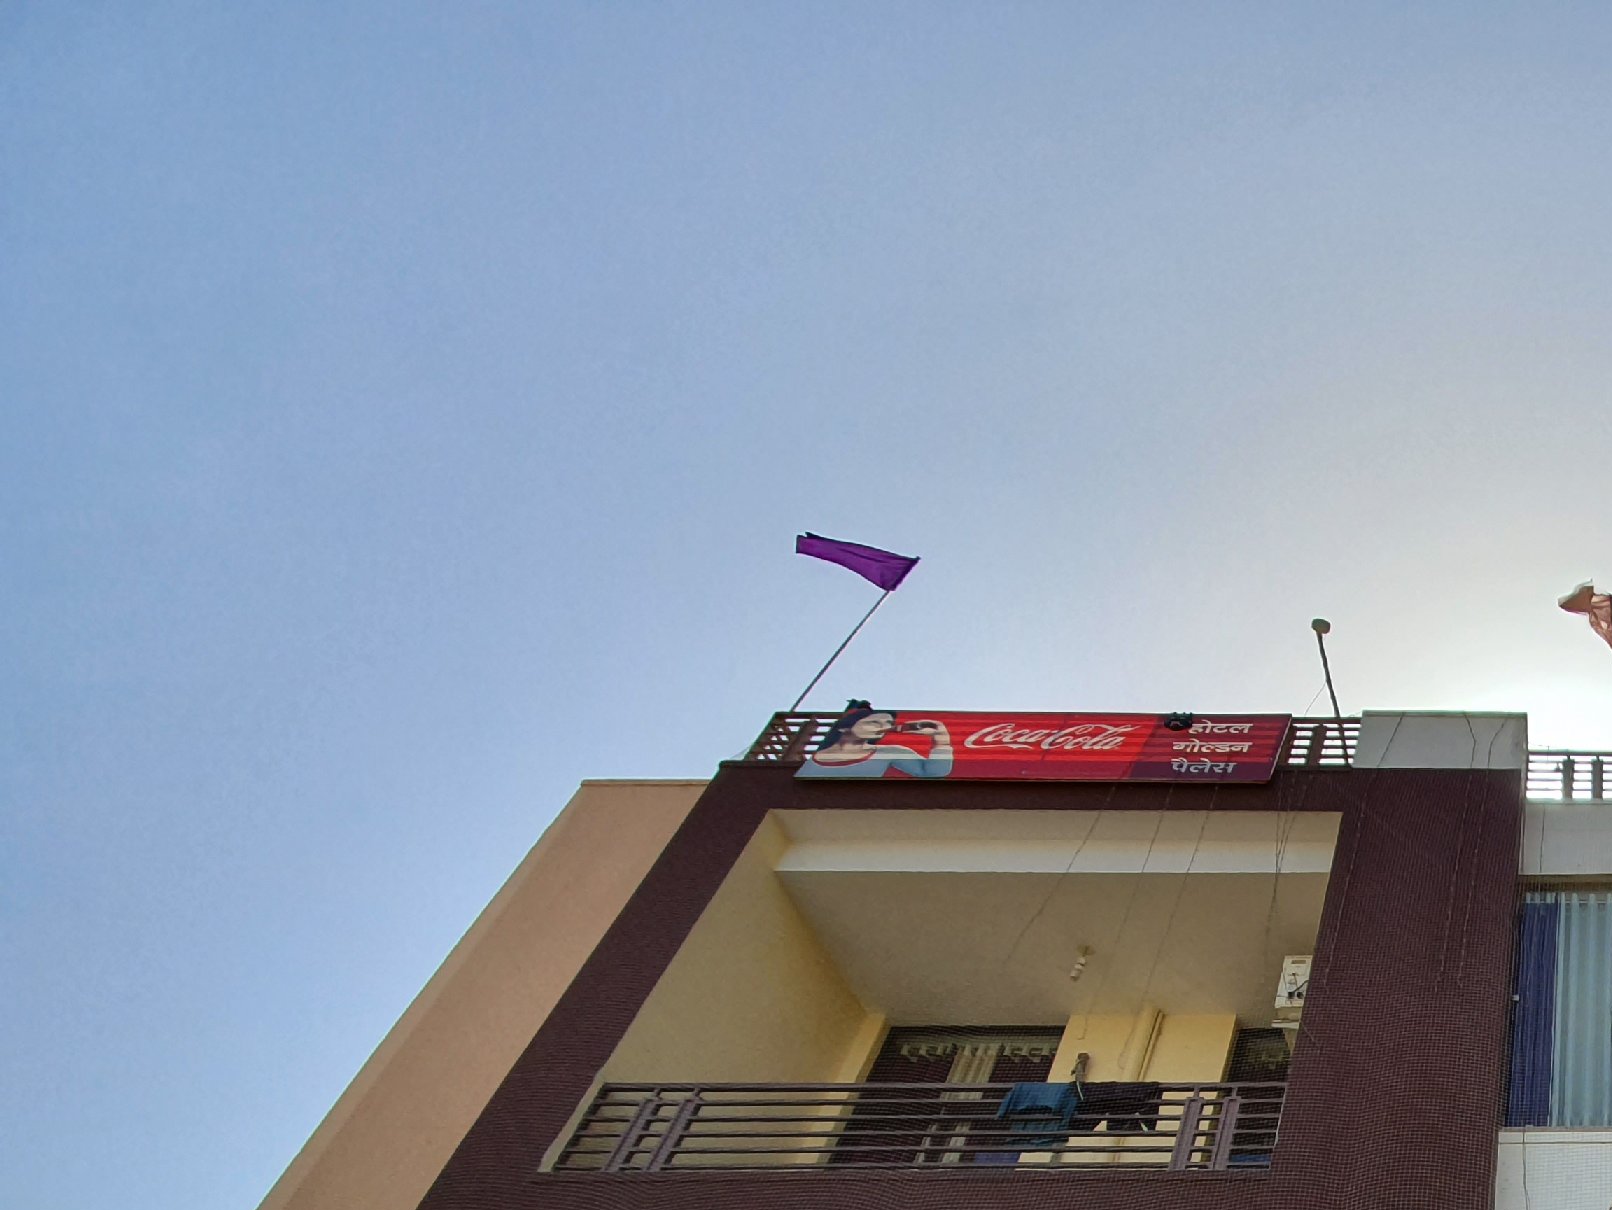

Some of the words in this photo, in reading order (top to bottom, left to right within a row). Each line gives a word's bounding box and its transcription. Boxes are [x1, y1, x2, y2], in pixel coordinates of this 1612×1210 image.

[1188, 719, 1253, 734] होटल
[963, 722, 1141, 751] Coca-Cola
[1172, 738, 1252, 753] गोल्डन
[1170, 757, 1237, 774] पैलेस
